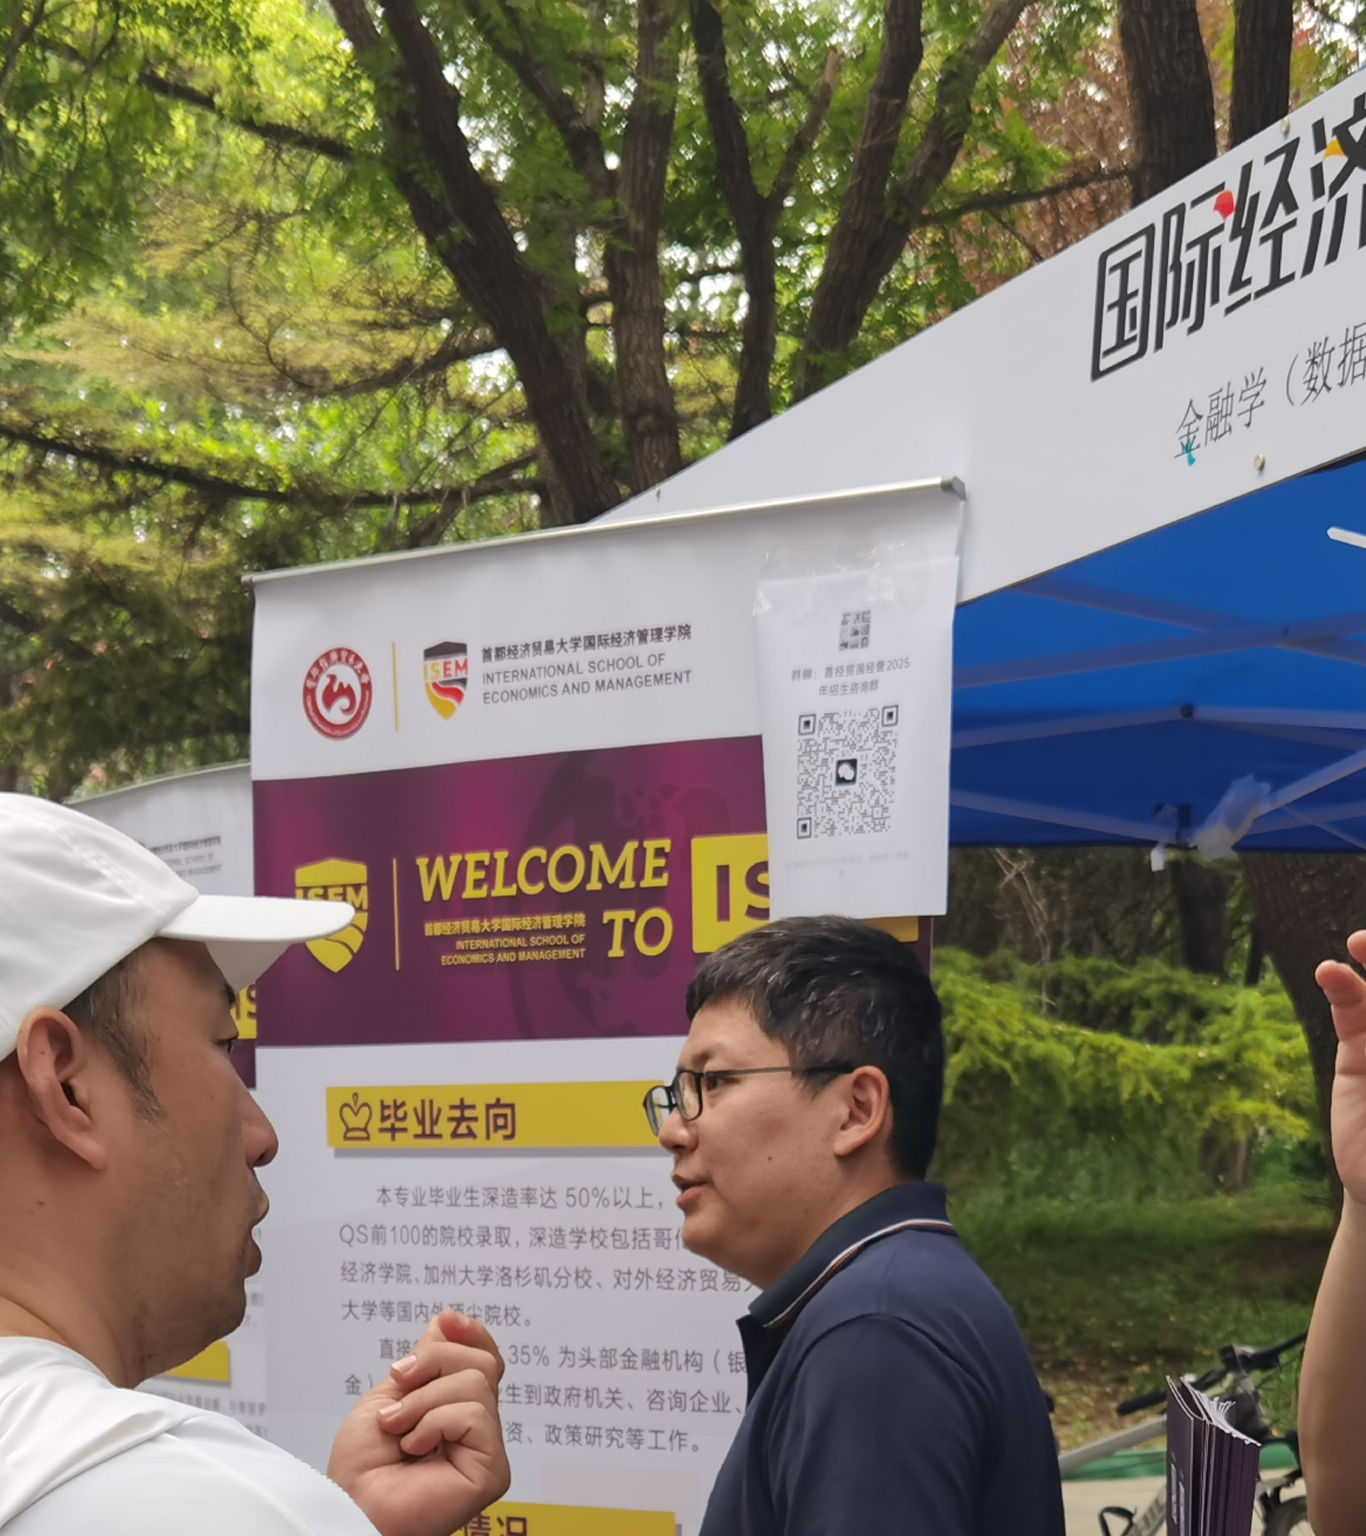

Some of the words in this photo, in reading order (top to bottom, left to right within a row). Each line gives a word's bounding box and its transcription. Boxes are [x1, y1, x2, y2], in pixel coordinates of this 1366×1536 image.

[481, 623, 692, 663] 首都经济贸易大学国际经济管理学院
[423, 657, 468, 684] ISEM
[482, 664, 585, 686] INTERNATIONAL
[587, 657, 642, 674] SCHOOL
[647, 653, 666, 669] OF
[482, 685, 559, 705] ECONOMICS
[562, 680, 592, 697] AND
[595, 671, 692, 694] MANAGEMENT
[416, 838, 672, 902] WELCOME
[455, 936, 528, 950] INTERNATIONAL
[529, 935, 567, 947] SCHOOL
[570, 933, 585, 944] OF
[602, 907, 673, 958] TO
[441, 952, 494, 966] ECONOMICS
[496, 951, 516, 963] AND
[517, 948, 586, 962] MANAGEMENT
[378, 1097, 516, 1142] 毕业去向
[376, 1186, 558, 1210] 本专业毕业生深造率达
[379, 1338, 418, 1361] 直接
[508, 1345, 550, 1367] 35%
